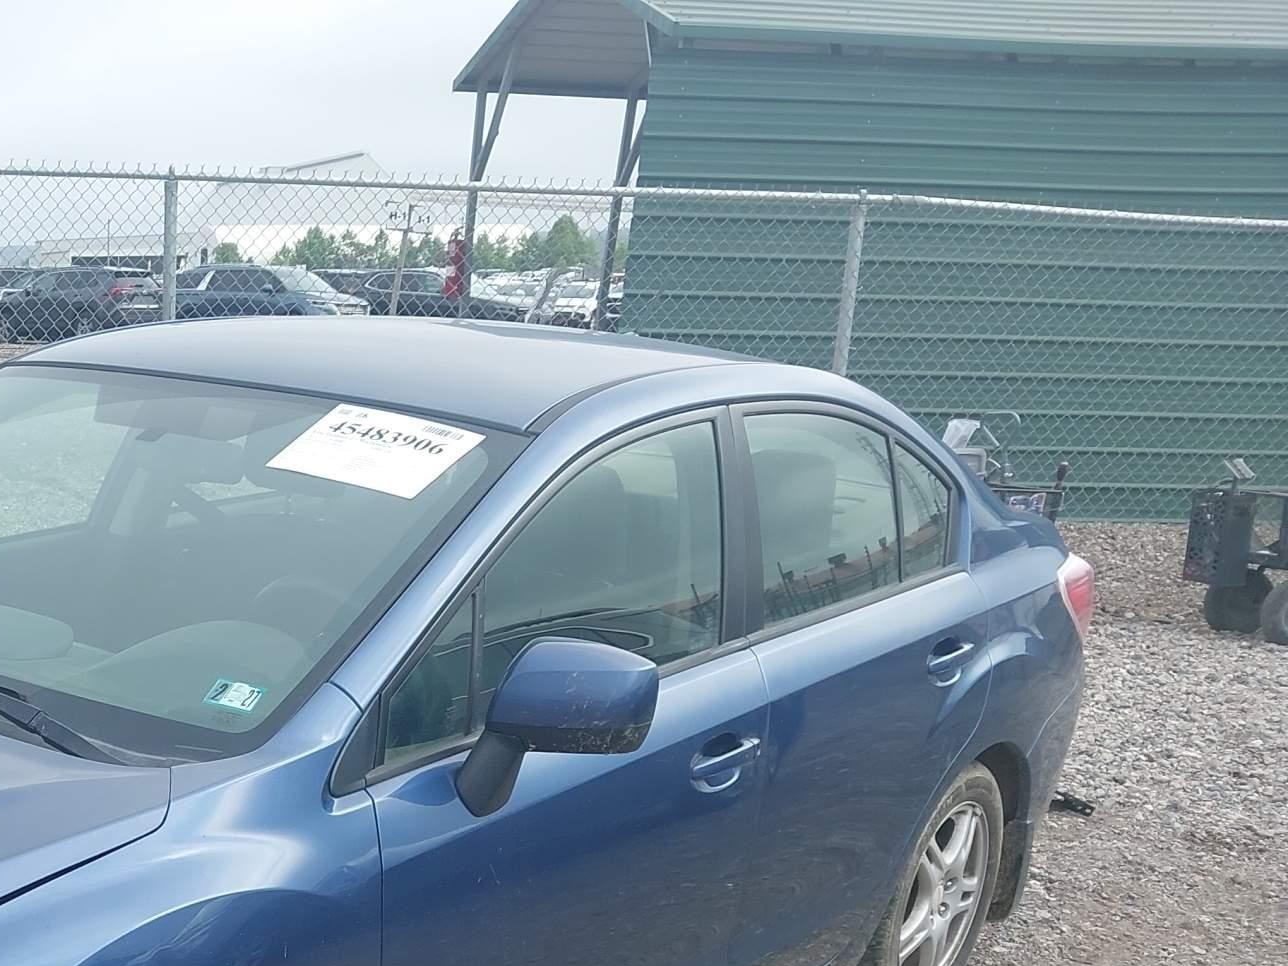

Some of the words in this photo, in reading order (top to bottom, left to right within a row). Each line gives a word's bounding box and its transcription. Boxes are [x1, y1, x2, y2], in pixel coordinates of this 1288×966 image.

[389, 211, 406, 221] H-1
[329, 421, 448, 455] 45483906
[210, 683, 229, 701] 2
[240, 689, 261, 708] 27
